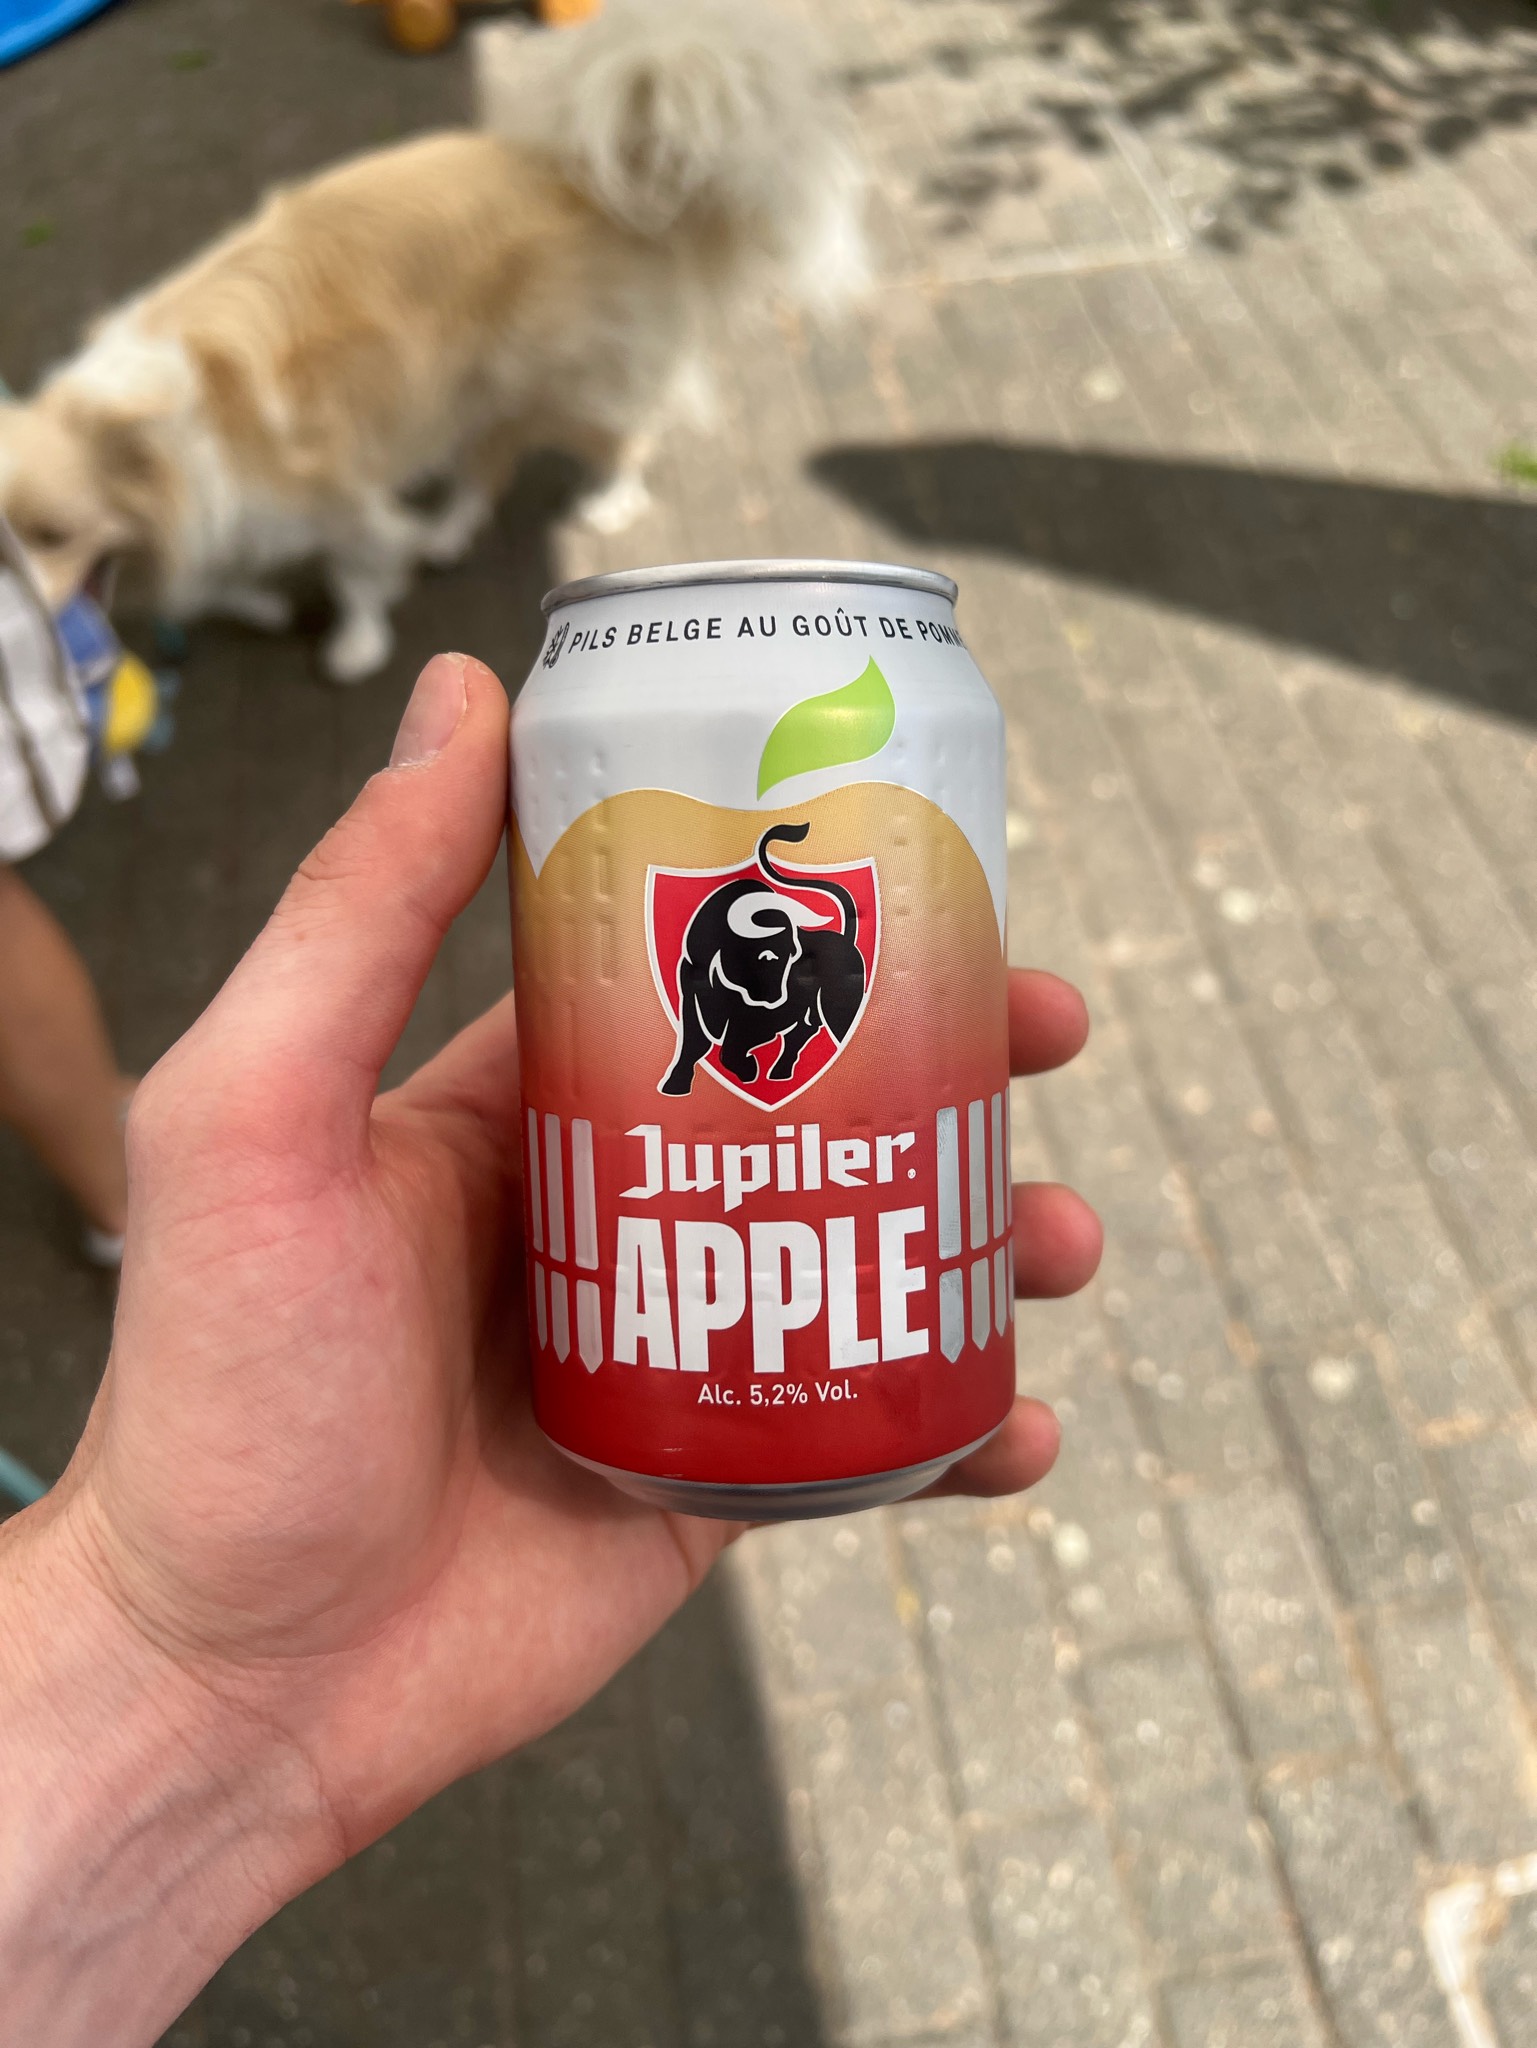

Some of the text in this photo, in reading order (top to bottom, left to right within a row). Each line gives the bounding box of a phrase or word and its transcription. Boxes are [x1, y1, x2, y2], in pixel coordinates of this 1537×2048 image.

[568, 626, 617, 653] PILS
[627, 618, 722, 645] BELGE
[737, 616, 776, 638] AU
[793, 607, 868, 637] GOÛT
[878, 617, 913, 640] DE
[613, 1205, 929, 1373] APPLE
[697, 1379, 858, 1407] Alc. 5,2% Vol.
